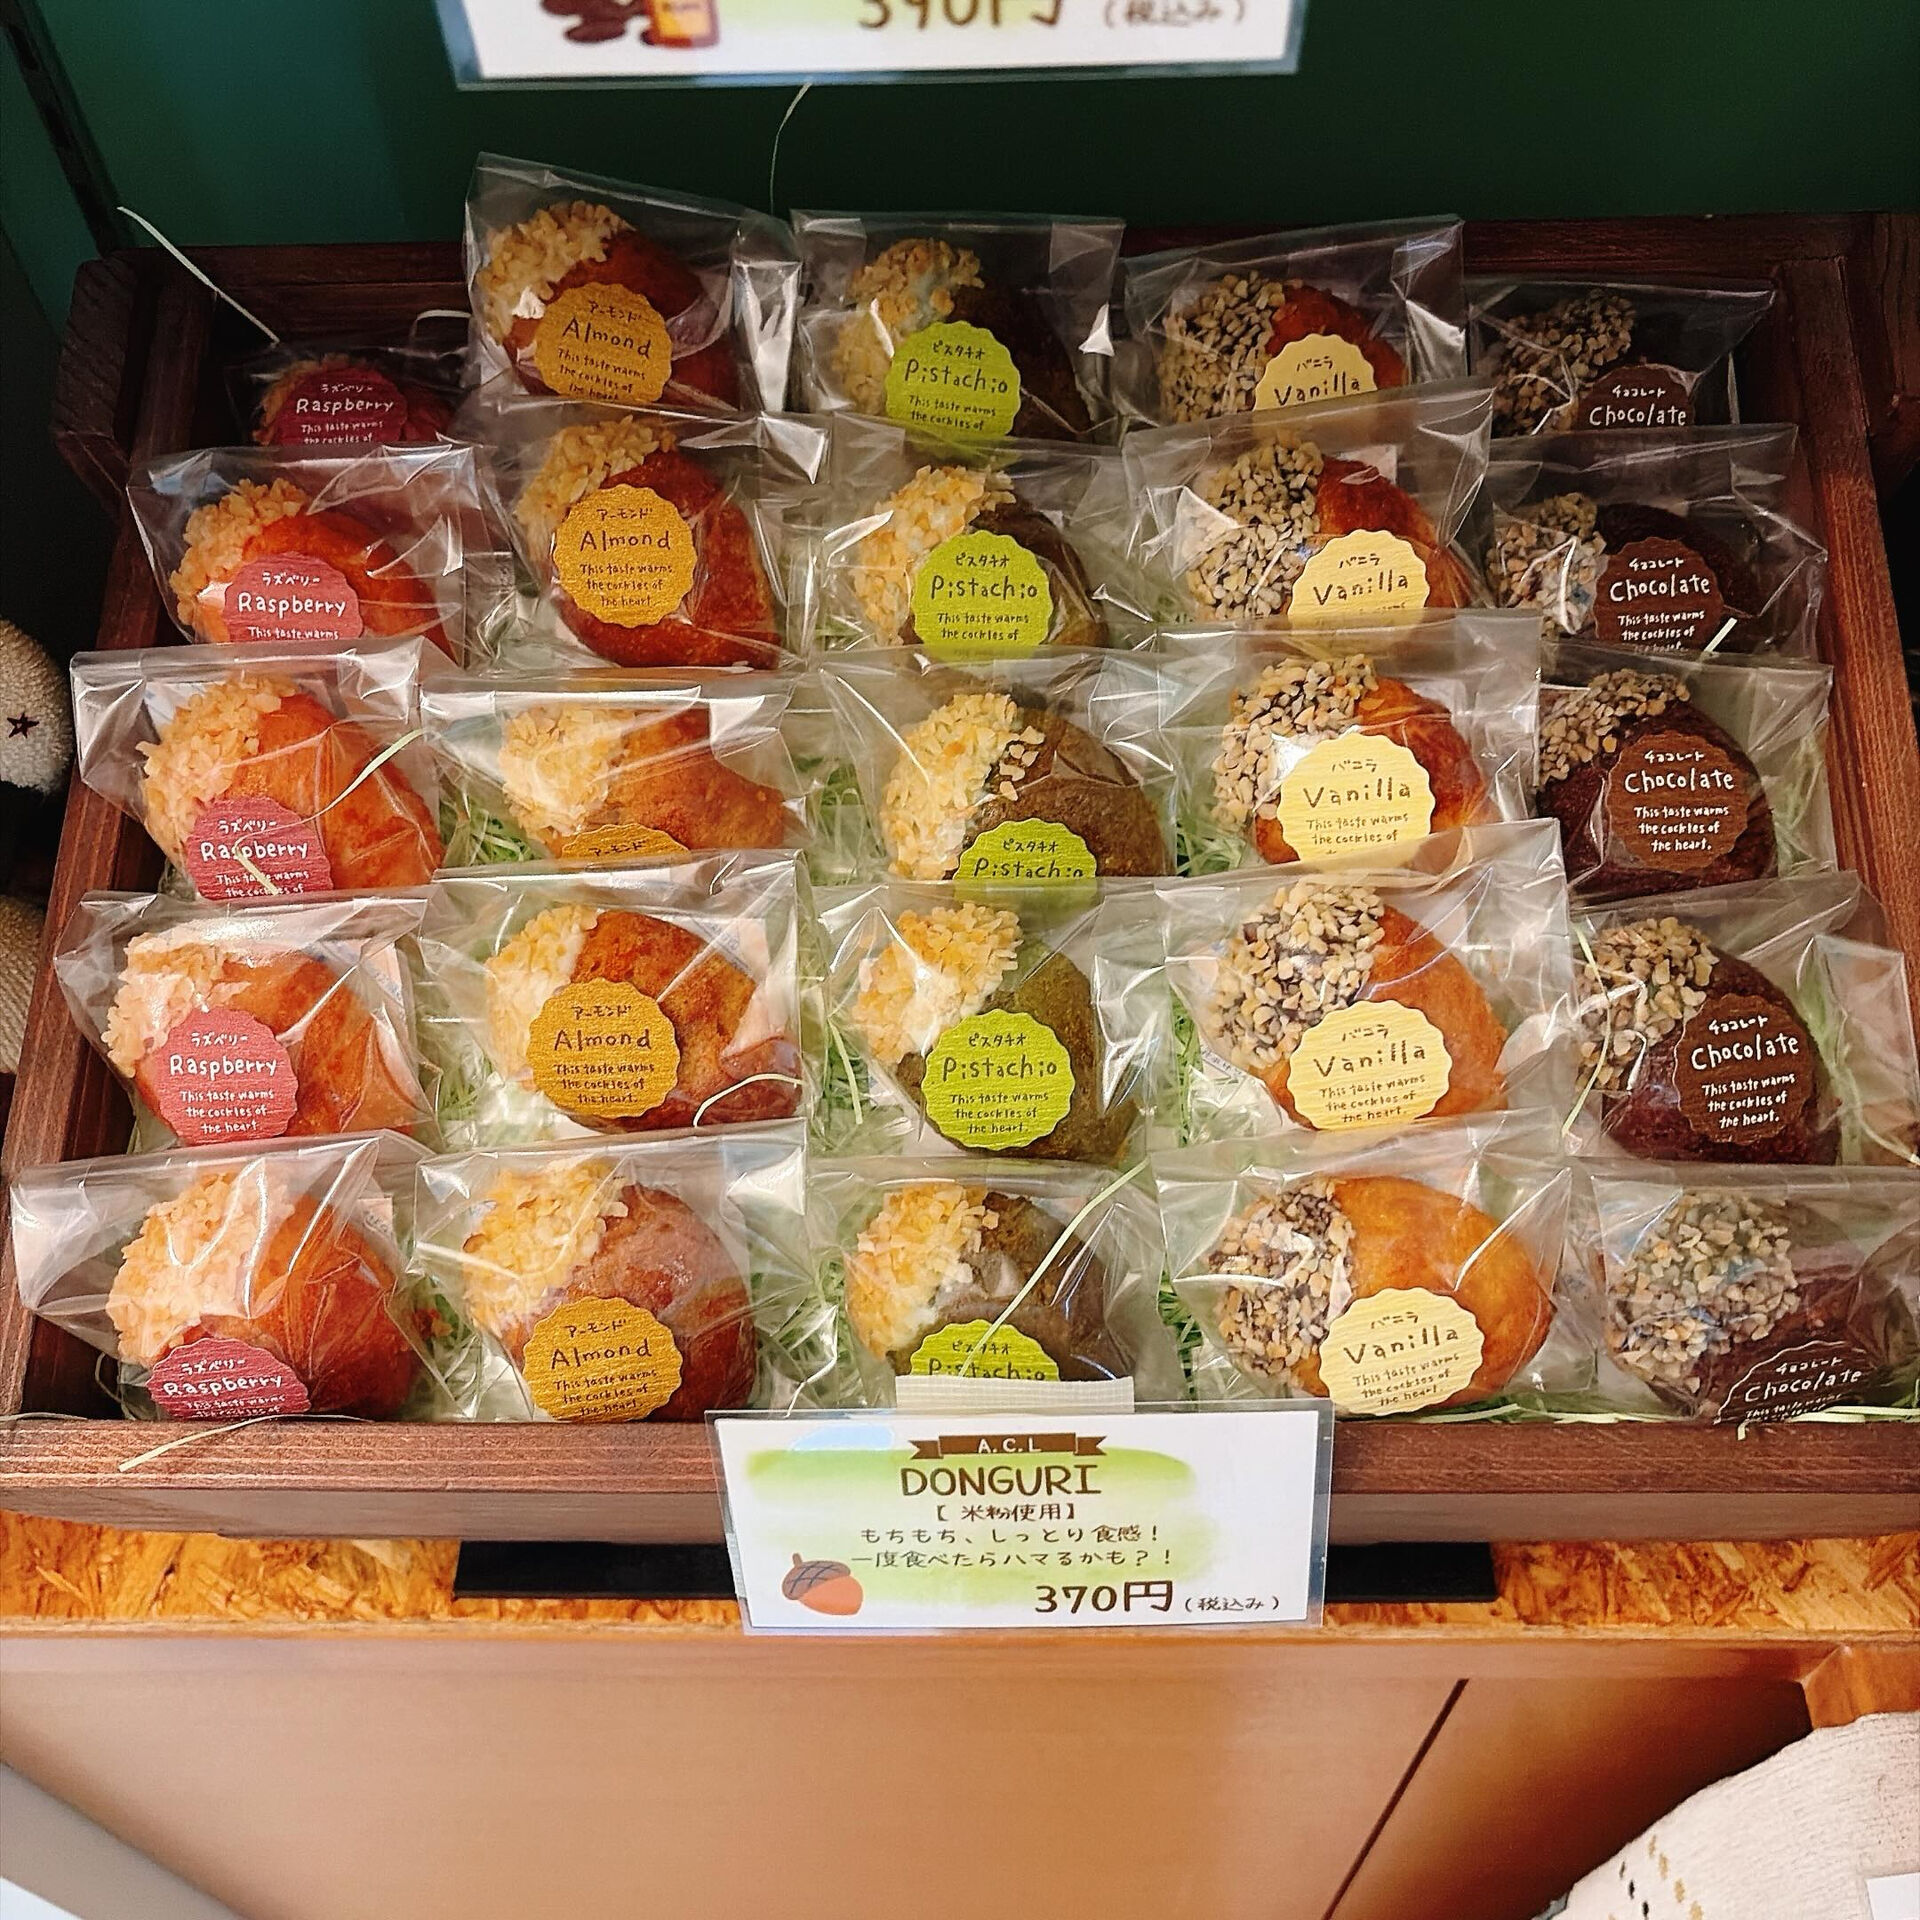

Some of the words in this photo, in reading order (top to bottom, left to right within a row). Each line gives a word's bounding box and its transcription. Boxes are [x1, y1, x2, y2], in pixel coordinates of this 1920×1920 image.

[562, 317, 650, 359] Almond
[1297, 356, 1334, 372] バニラ
[905, 359, 1008, 393] Pistachio
[1274, 371, 1360, 406] Vanilla
[296, 398, 394, 415] Raspberry
[1589, 403, 1687, 426] Chocolate
[580, 530, 671, 552] Almond
[956, 552, 1010, 567] ピスタチオ
[1338, 553, 1381, 568] バニラ
[262, 572, 320, 586] ラズベリー
[580, 563, 603, 576] This
[606, 564, 635, 576] taste
[638, 564, 674, 573] warms
[931, 575, 1038, 601] Pistachio
[1313, 569, 1408, 606] Vanilla
[1610, 574, 1711, 602] Chocolate
[238, 592, 346, 619] Raspberry
[937, 613, 961, 625] This
[965, 613, 992, 624] taste
[995, 614, 1029, 624] warms
[1618, 613, 1641, 627] This
[1643, 611, 1670, 625] taste
[1673, 610, 1705, 620] warms
[247, 626, 272, 639] This
[275, 628, 301, 639] taste
[304, 629, 339, 640] warms
[1621, 629, 1638, 641] the
[1641, 629, 1681, 641] cockles
[1684, 625, 1695, 637] of
[1332, 759, 1377, 773] バニラ
[1625, 767, 1734, 793] Chocolate
[1303, 777, 1410, 808] Vanilla
[1306, 819, 1332, 830] This
[1335, 815, 1365, 829] taste
[1369, 813, 1408, 824] warms
[1634, 806, 1659, 819] This
[1661, 806, 1691, 819] taste
[1693, 806, 1729, 816] warms
[218, 818, 278, 834] ラズベリー
[1639, 822, 1657, 834] the
[1660, 822, 1705, 834] cockles
[1708, 821, 1720, 834] of
[1003, 838, 1058, 852] ピスタチオ
[1651, 840, 1671, 852] the
[1675, 838, 1712, 851] heart.
[571, 1005, 631, 1020] アーモンド
[191, 1031, 248, 1046] ラズベリー
[554, 1028, 651, 1052] Almond
[968, 1033, 1026, 1047] ピスタチオ
[1342, 1024, 1389, 1041] バニラ
[1313, 1040, 1425, 1077] Vanilla
[1691, 1033, 1799, 1070] Chocolate
[169, 1054, 276, 1081] Raspberry
[554, 1063, 580, 1075] This
[583, 1064, 613, 1074] taste
[616, 1064, 654, 1073] warms
[942, 1054, 1057, 1082] Pistachio
[1320, 1086, 1346, 1100] This
[1350, 1081, 1382, 1095] taste
[1386, 1075, 1426, 1088] warms
[1702, 1083, 1727, 1097] This
[1730, 1078, 1758, 1094] taste
[1761, 1073, 1796, 1088] warms
[181, 1090, 204, 1103] This
[206, 1090, 235, 1102] taste
[238, 1089, 274, 1099] warms
[950, 1094, 975, 1105] This
[980, 1093, 1008, 1104] taste
[1012, 1092, 1048, 1102] warms
[1708, 1100, 1726, 1113] the
[1729, 1096, 1773, 1110] cockles
[1776, 1090, 1788, 1104] of
[186, 1106, 205, 1117] the
[207, 1105, 251, 1117] cockles
[255, 1104, 267, 1115] of
[955, 1108, 973, 1119] the
[977, 1109, 1021, 1118] cockles
[1026, 1107, 1037, 1118] of
[1720, 1116, 1739, 1129] the
[1743, 1109, 1780, 1126] heart.
[564, 1319, 626, 1338] アーモンド
[1371, 1311, 1419, 1329] バニラ
[551, 1337, 652, 1369] Almond
[1343, 1325, 1458, 1364] Vanilla
[181, 1359, 246, 1376] ラズベリー
[1352, 1374, 1380, 1387] This
[1385, 1365, 1417, 1380] taste
[1420, 1353, 1460, 1370] warms
[163, 1375, 281, 1397] Raspberry
[554, 1379, 580, 1391] This
[586, 1375, 615, 1388] taste
[619, 1369, 657, 1381] warms
[1745, 1370, 1862, 1402] Chocolate
[901, 1464, 1103, 1497] DONGURI
[1034, 1580, 1174, 1614] 370円
[1185, 1596, 1280, 1614] (税込み)
